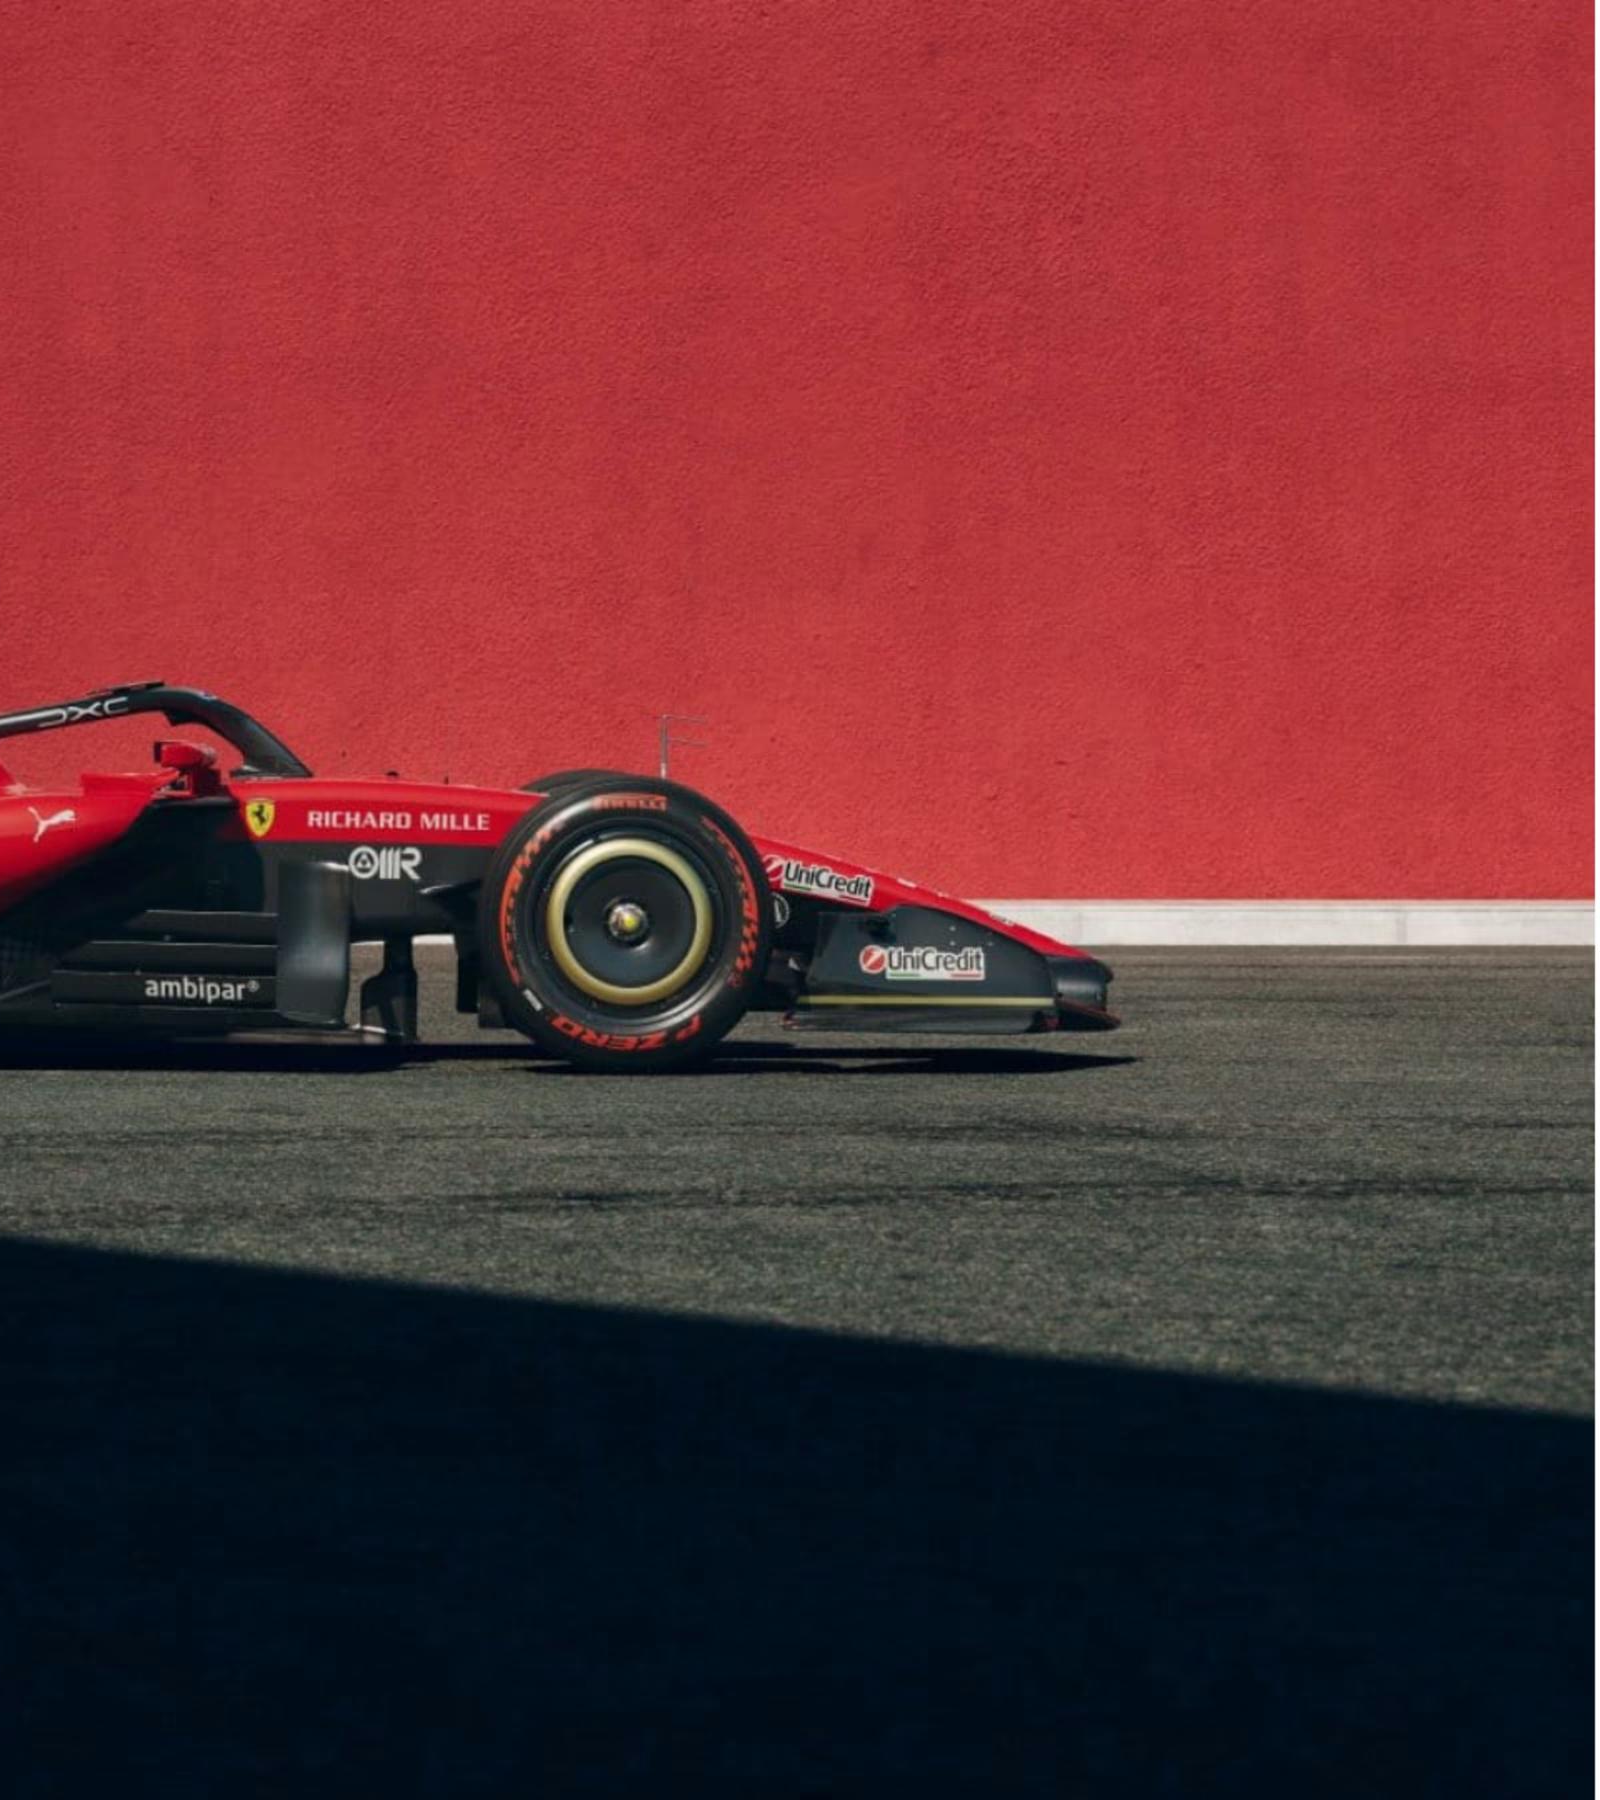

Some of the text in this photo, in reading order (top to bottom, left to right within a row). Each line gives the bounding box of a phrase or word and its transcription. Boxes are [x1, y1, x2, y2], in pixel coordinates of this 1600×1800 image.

[37, 696, 128, 728] DXC
[308, 809, 490, 831] RICHARD MILLE
[785, 861, 871, 898] UniCredit
[888, 950, 983, 971] UniCredit
